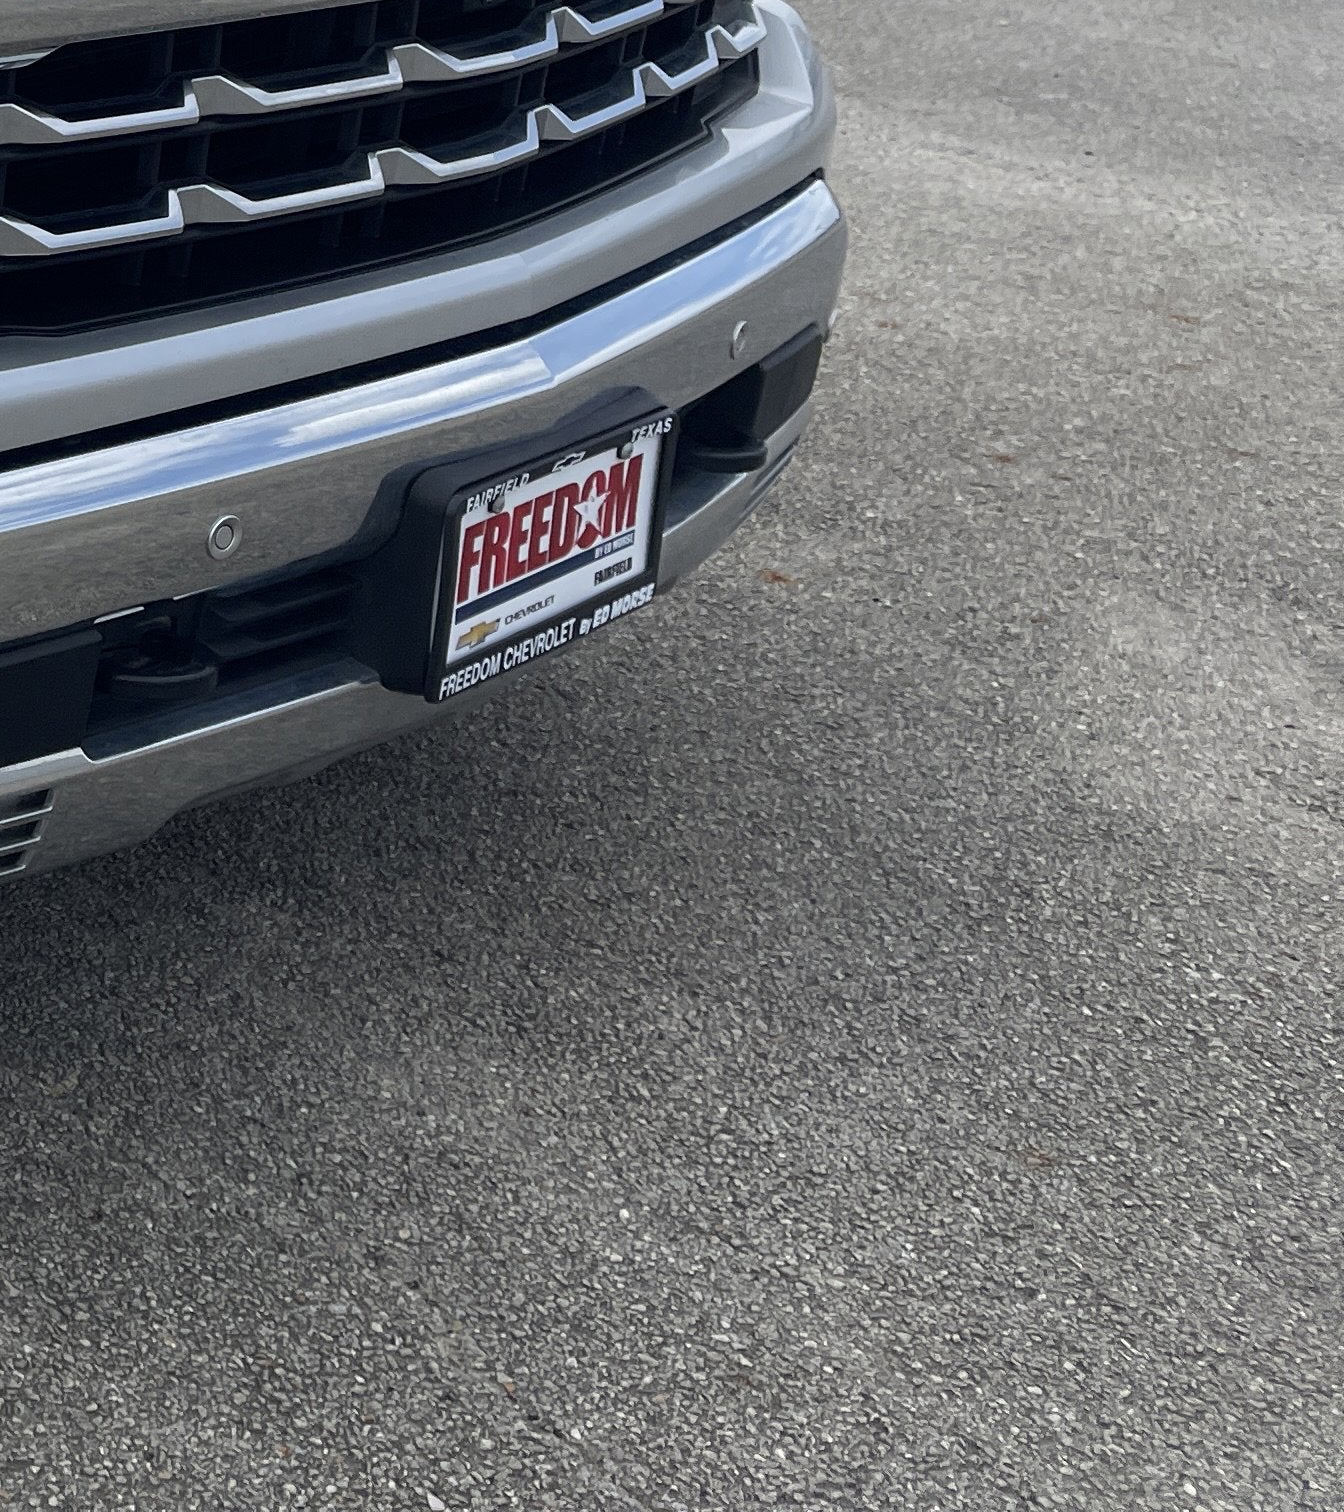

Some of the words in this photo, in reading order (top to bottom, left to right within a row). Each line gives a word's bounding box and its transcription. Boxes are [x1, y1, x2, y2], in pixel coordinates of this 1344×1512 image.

[466, 473, 530, 513] FAIRFIELD
[631, 417, 673, 443] TEXAS
[456, 454, 644, 605] FREEDOM
[439, 653, 501, 701] FREEDOM
[503, 618, 576, 670] CHEVROLET
[593, 603, 610, 629] ED
[611, 583, 656, 619] MORSE
[504, 595, 555, 625] CHEVROLET
